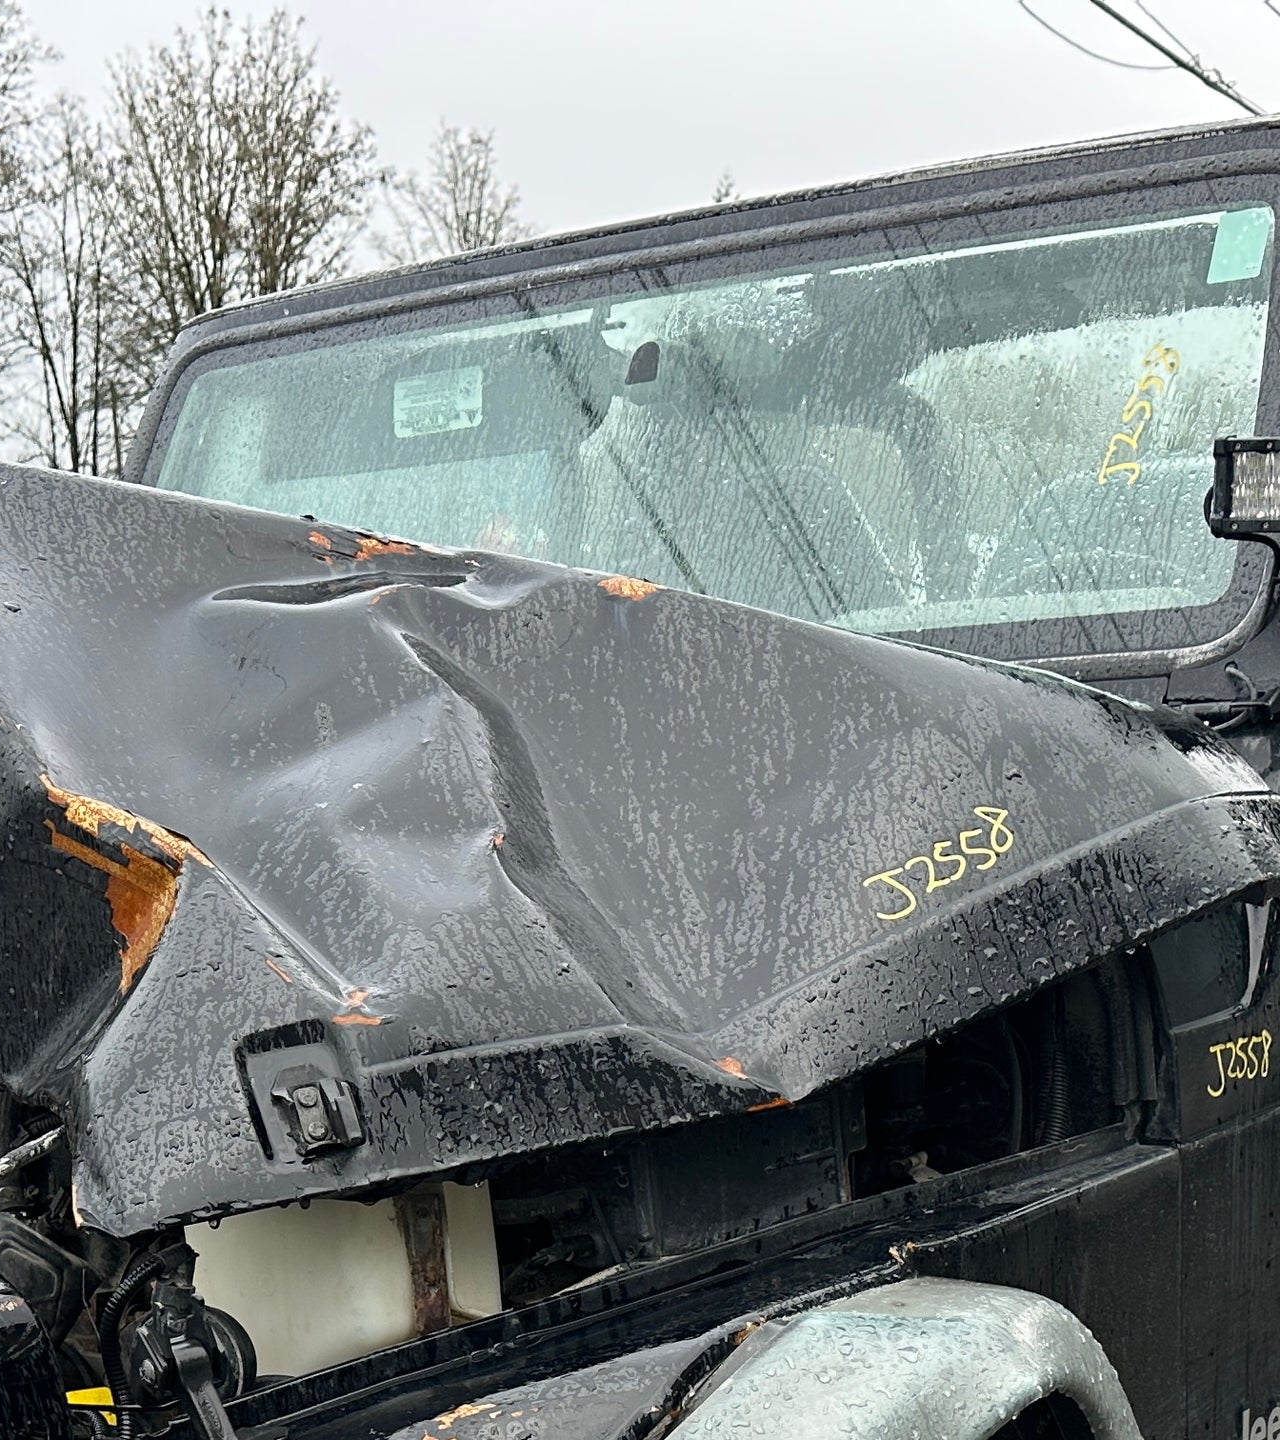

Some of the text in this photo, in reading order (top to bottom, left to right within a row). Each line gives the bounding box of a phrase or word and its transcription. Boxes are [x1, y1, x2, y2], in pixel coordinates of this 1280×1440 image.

[1098, 340, 1180, 486] J2558
[862, 806, 1014, 920] J2558
[1206, 1029, 1272, 1098] J2558
